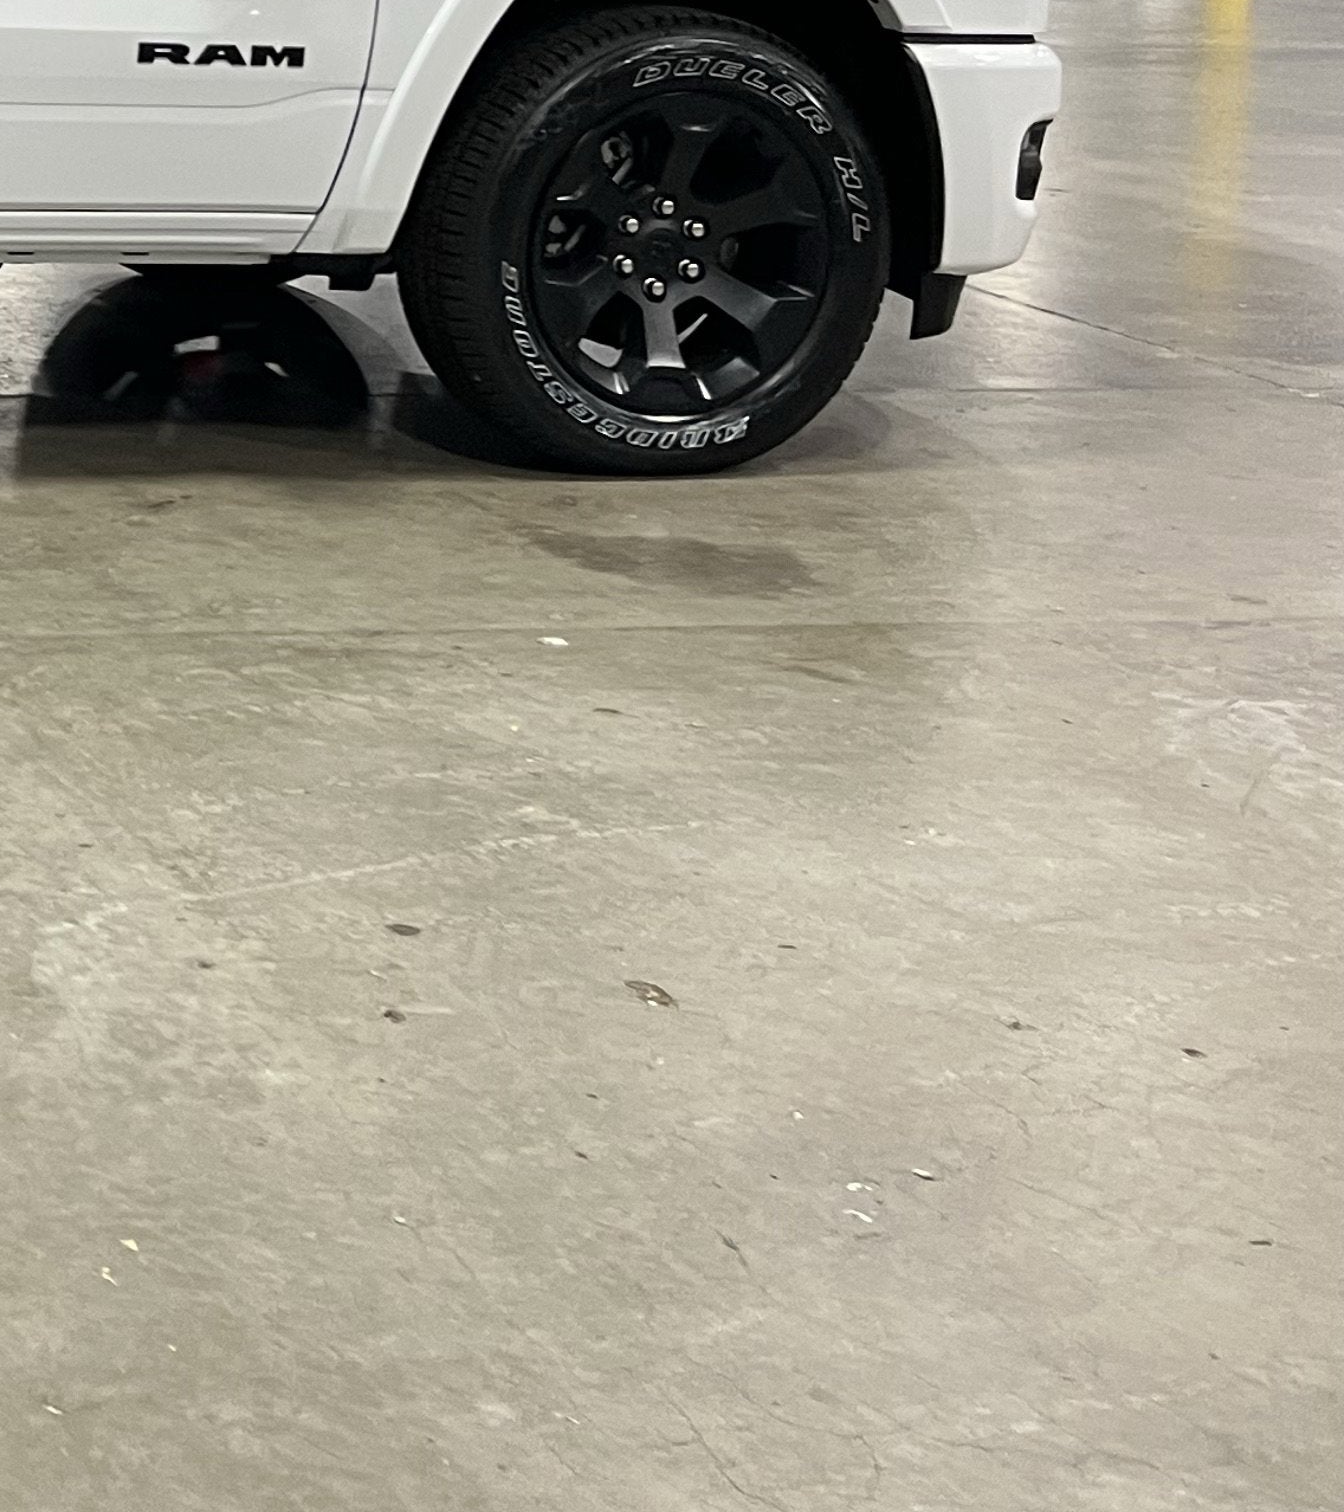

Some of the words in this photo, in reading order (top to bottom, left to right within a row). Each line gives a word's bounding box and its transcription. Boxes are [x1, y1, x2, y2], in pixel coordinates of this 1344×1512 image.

[137, 41, 305, 68] RAM
[632, 57, 833, 135] DUELER
[833, 156, 871, 243] H/L
[501, 260, 751, 450] BRIDGESTONE
